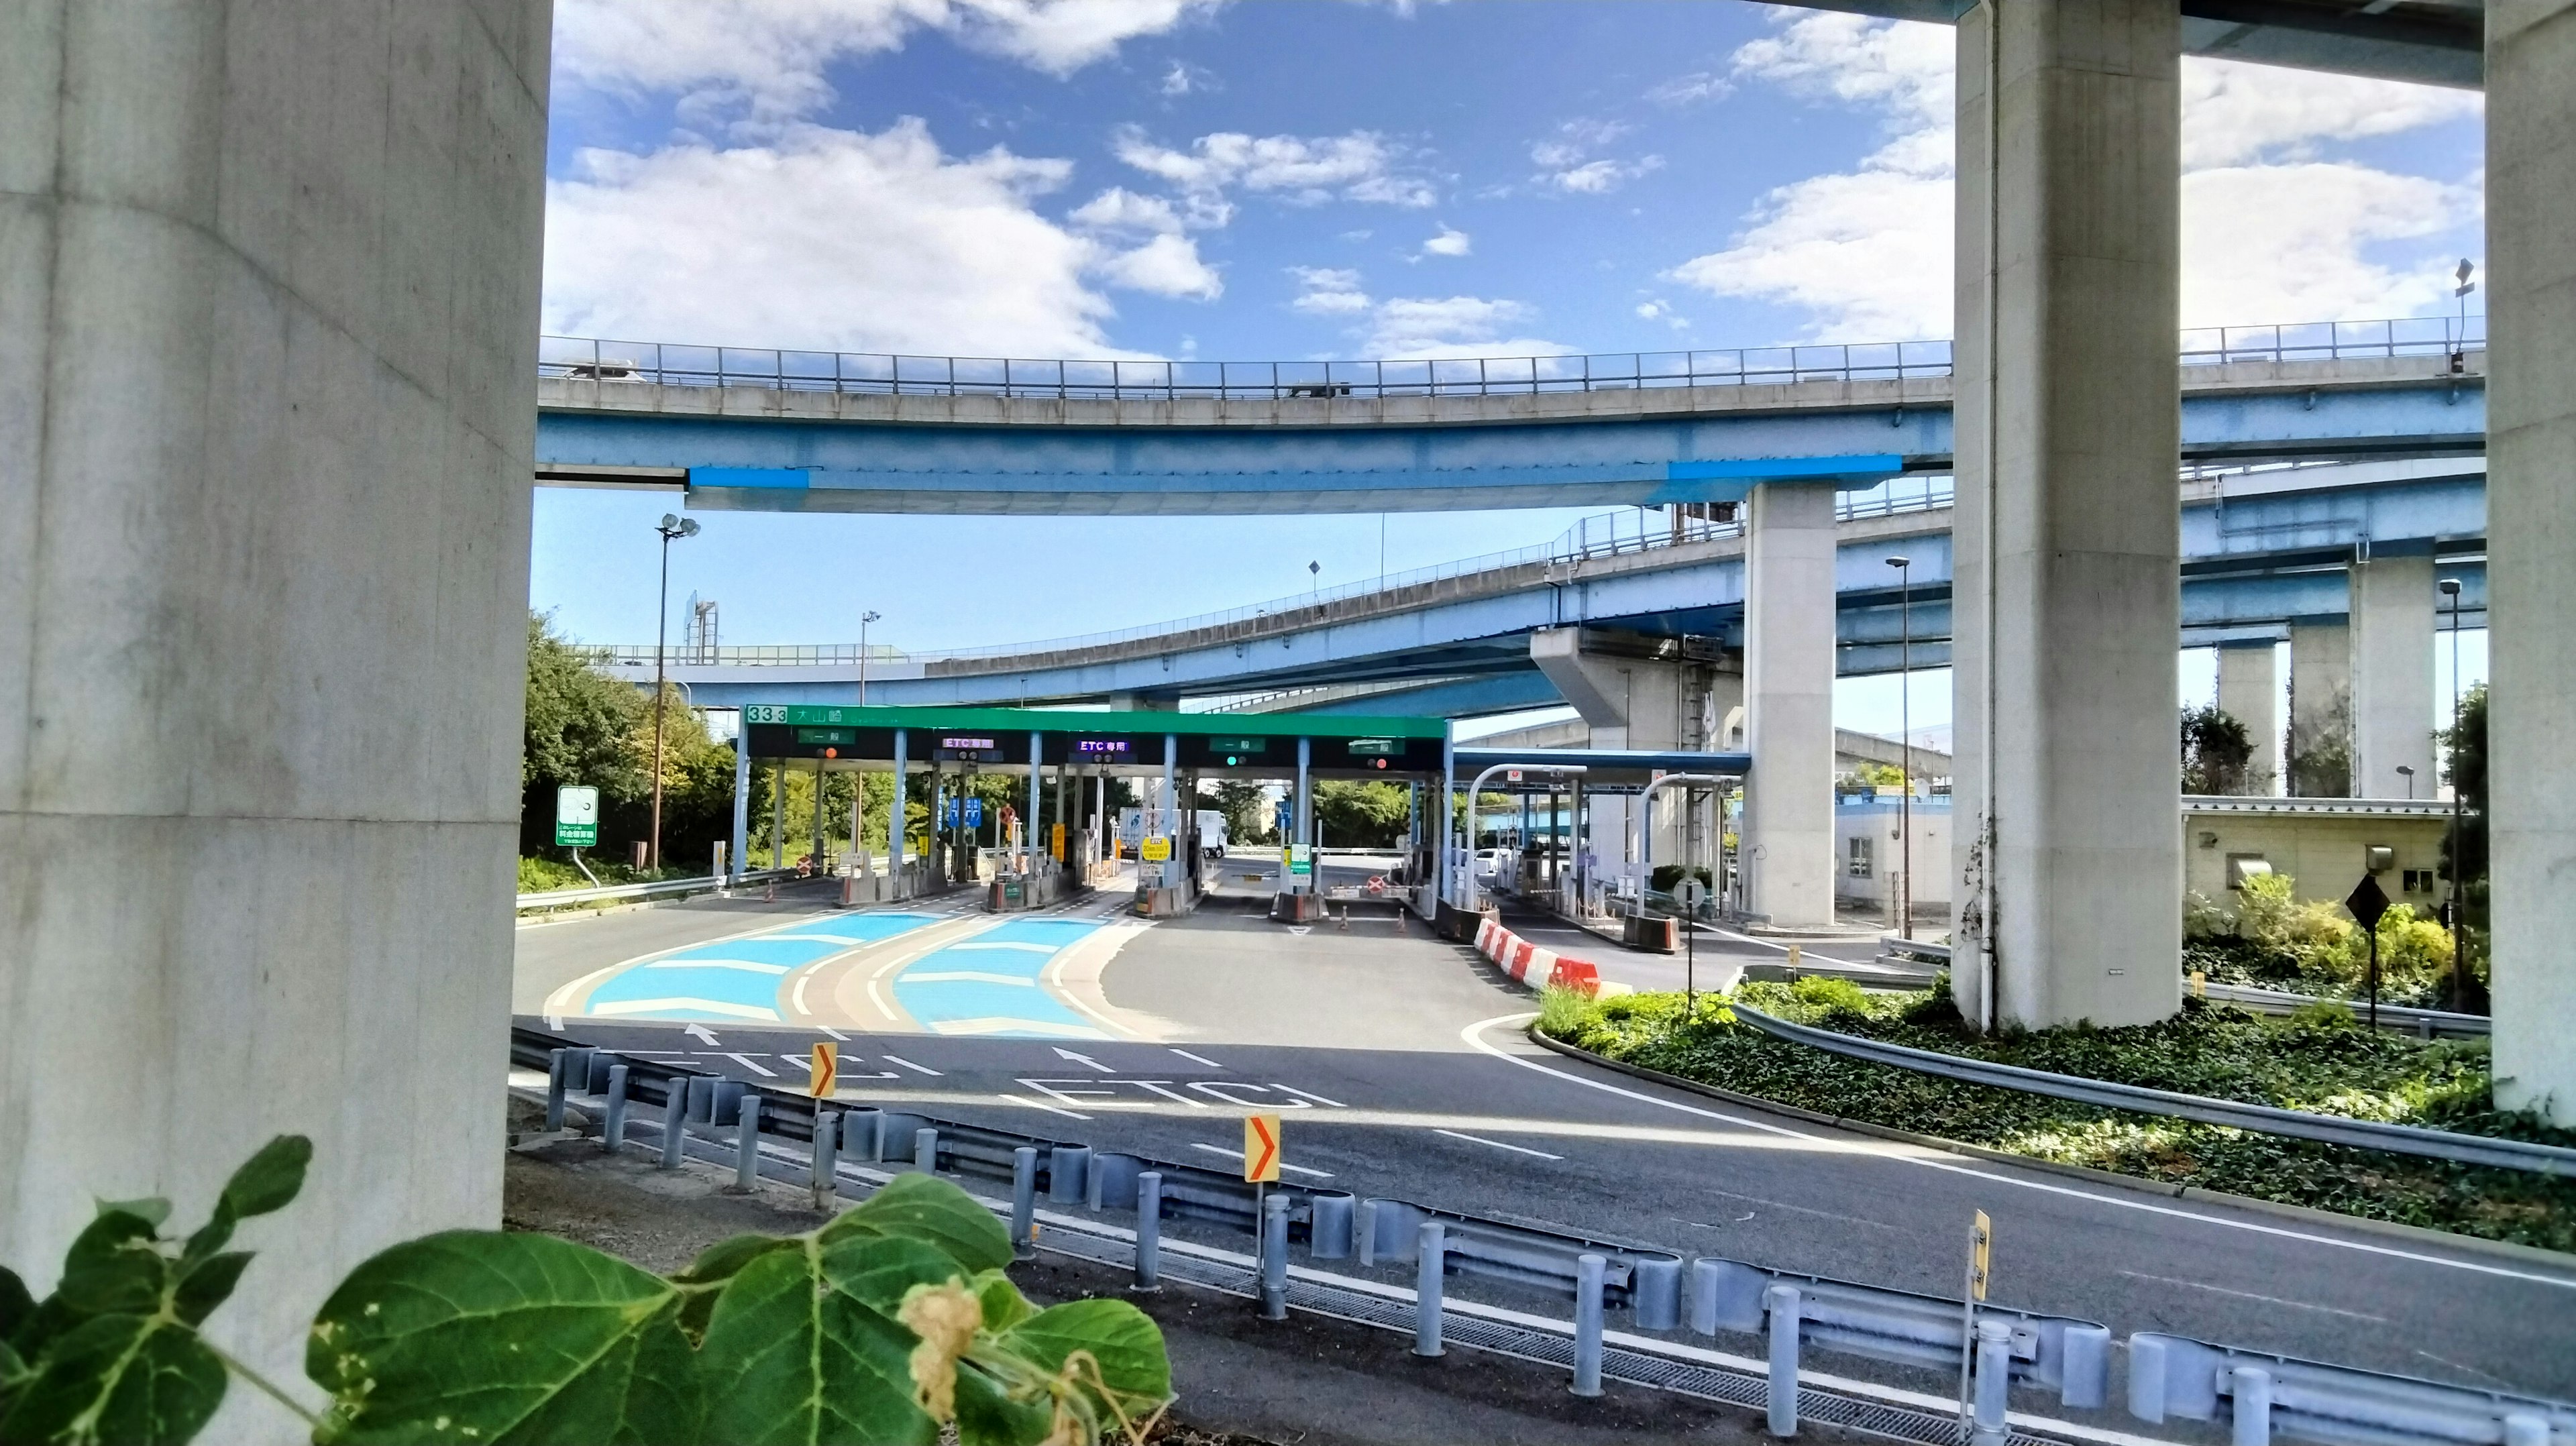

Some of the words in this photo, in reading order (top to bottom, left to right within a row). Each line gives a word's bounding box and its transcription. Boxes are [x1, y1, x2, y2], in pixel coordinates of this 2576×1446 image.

[797, 710, 842, 722] 大山崎
[814, 732, 839, 741] 一般
[1226, 740, 1250, 749] 一般
[1364, 743, 1389, 752] 一般
[1014, 1078, 1313, 1108] ETC
